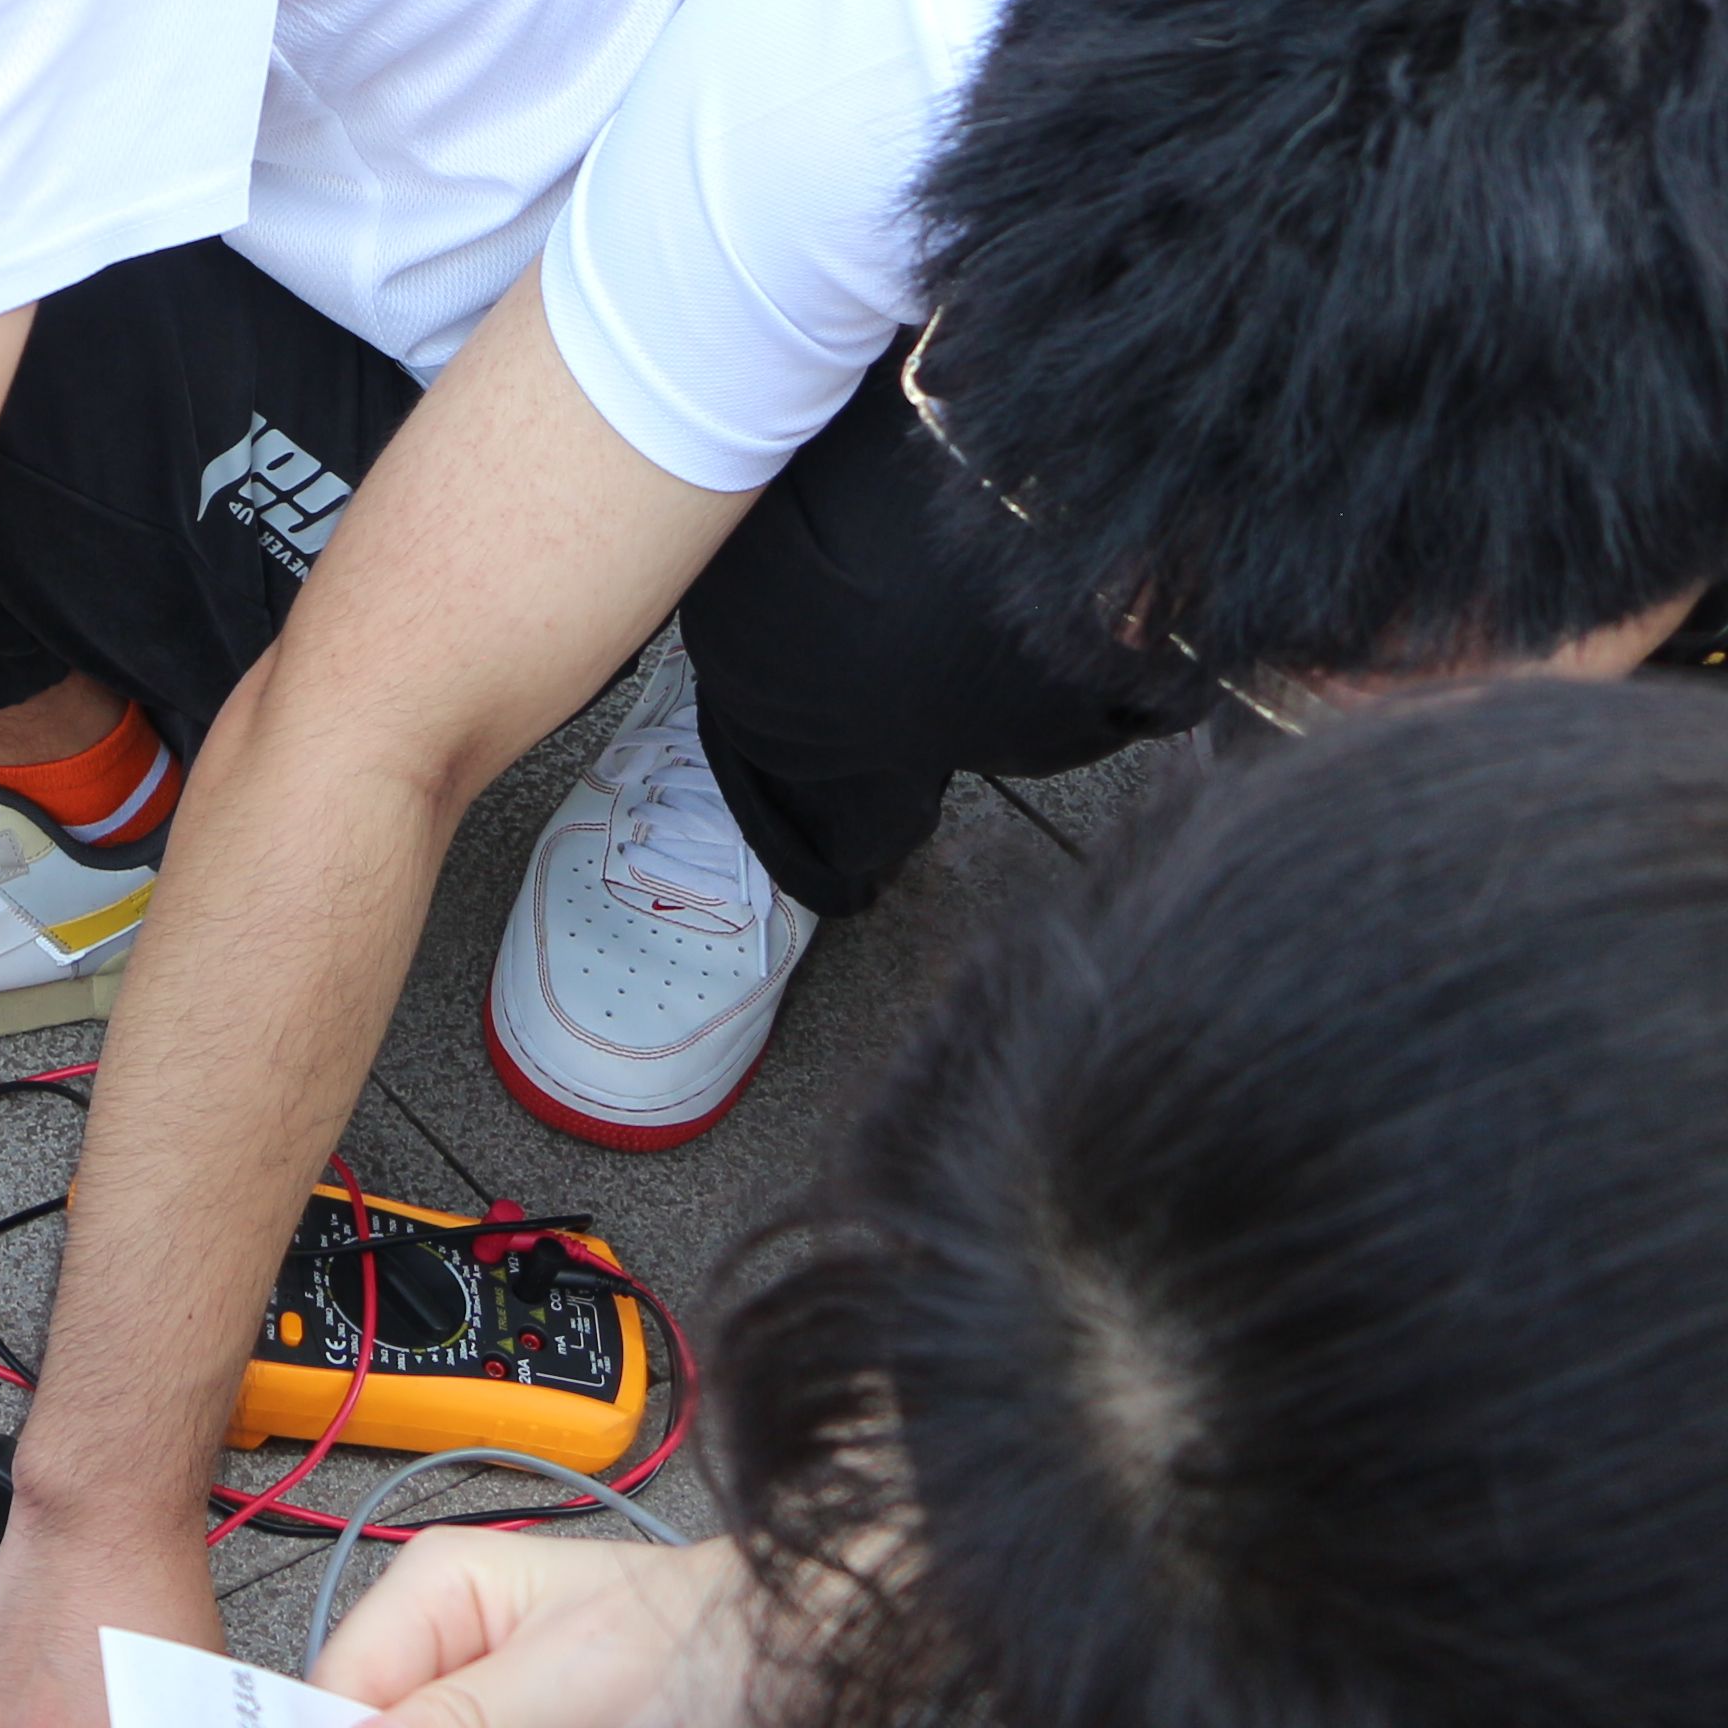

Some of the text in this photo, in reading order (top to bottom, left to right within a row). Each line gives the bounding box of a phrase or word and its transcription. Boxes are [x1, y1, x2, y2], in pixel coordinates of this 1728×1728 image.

[228, 501, 255, 526] UP
[497, 1307, 507, 1331] TRUE
[325, 1338, 347, 1364] CE
[554, 1335, 567, 1355] mA
[517, 1358, 532, 1384] 20A
